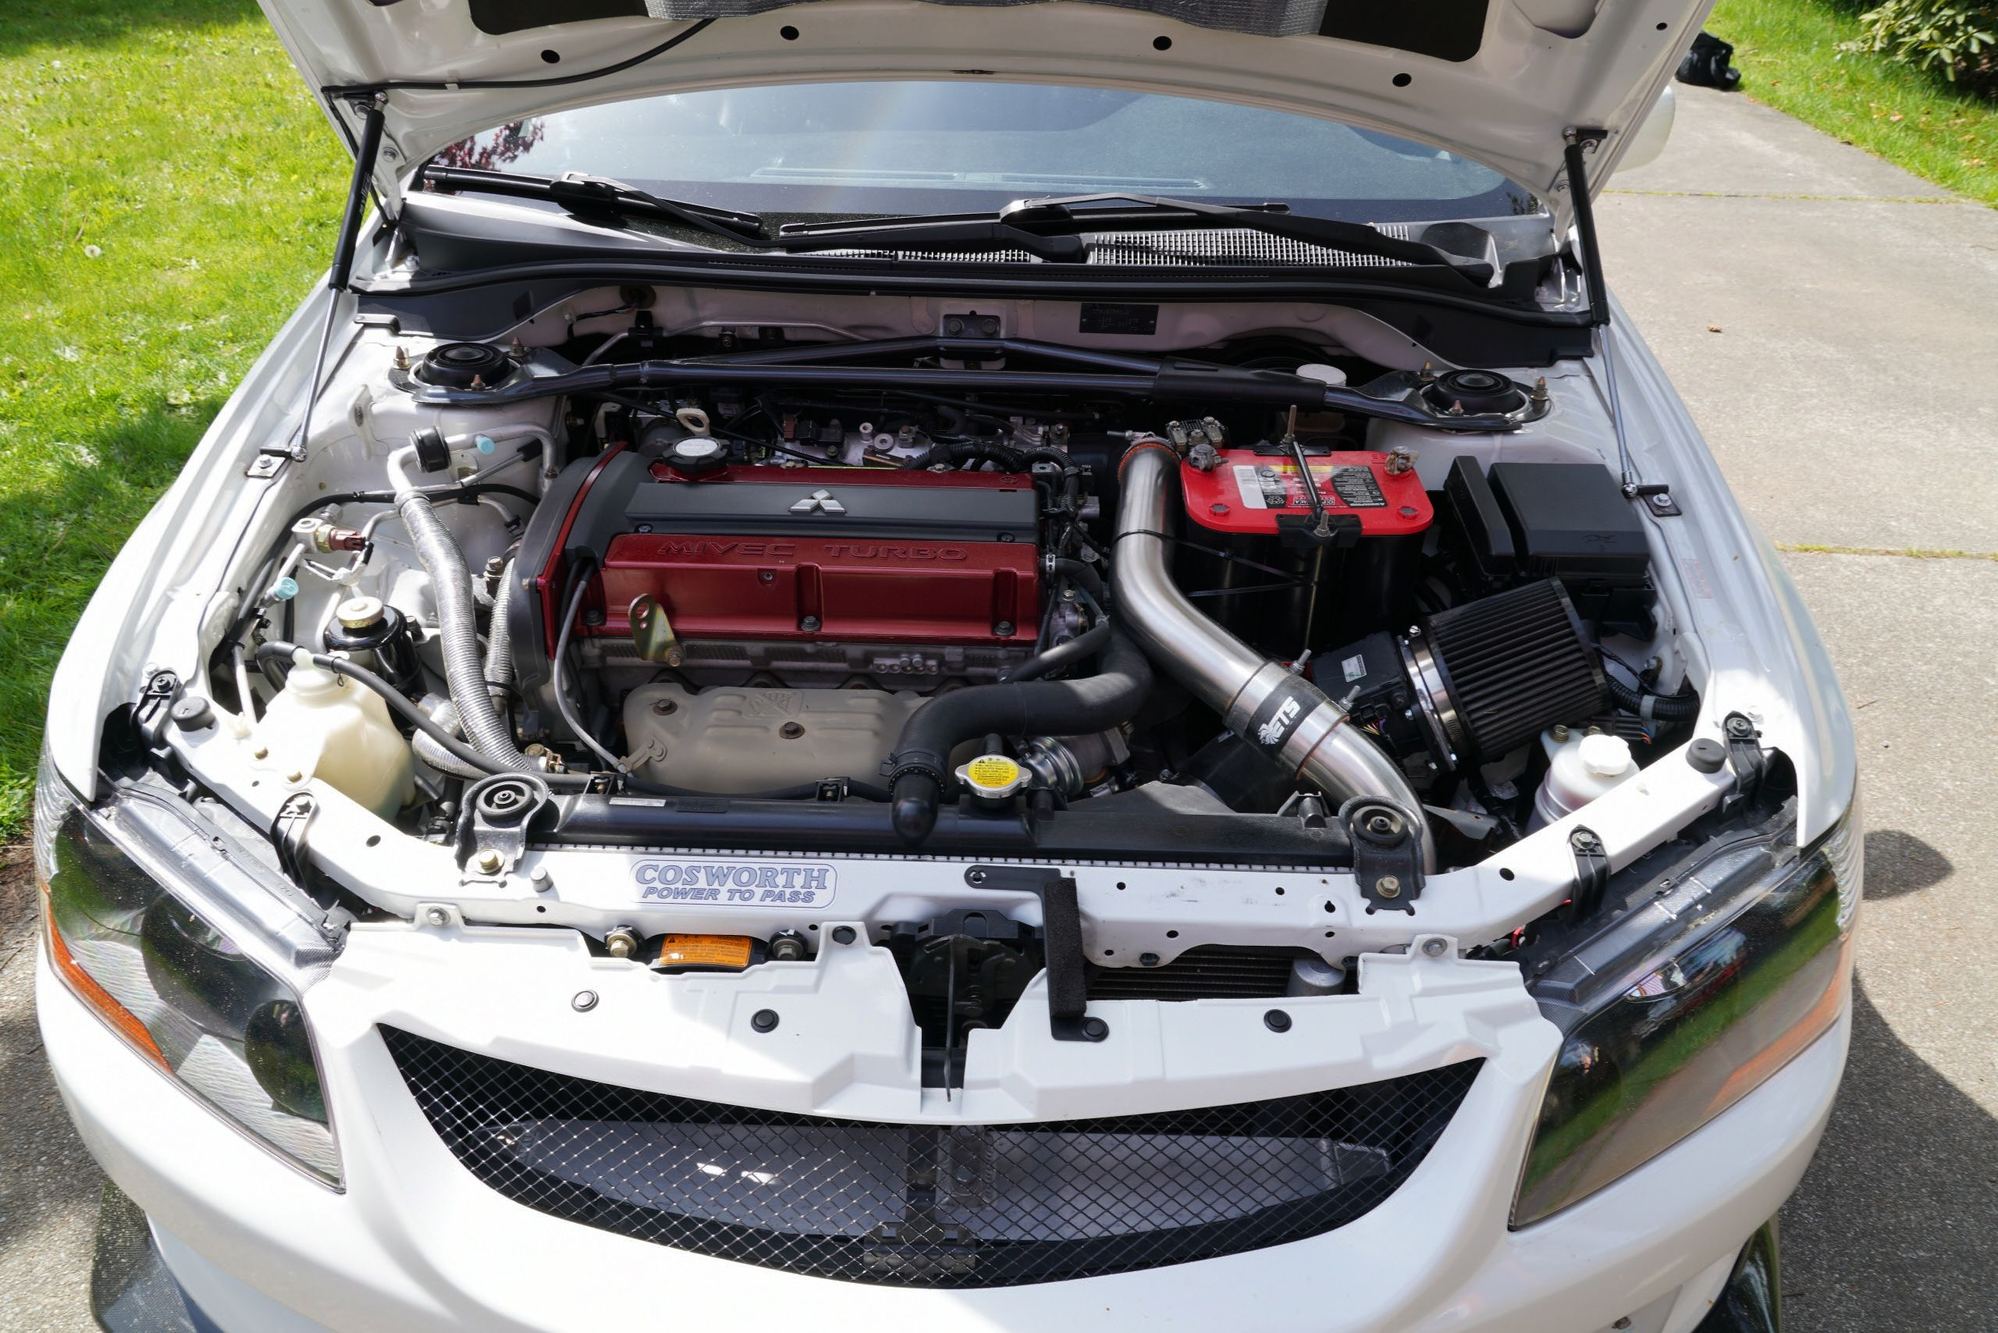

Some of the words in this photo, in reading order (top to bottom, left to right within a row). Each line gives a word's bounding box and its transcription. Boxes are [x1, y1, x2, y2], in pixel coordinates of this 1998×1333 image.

[656, 540, 796, 556] MIVEC
[823, 543, 967, 561] TURBO
[1265, 695, 1301, 739] ETS
[635, 864, 829, 890] COSWORTH
[641, 886, 720, 901] POWER
[727, 888, 755, 901] TO
[759, 889, 816, 904] PASS
